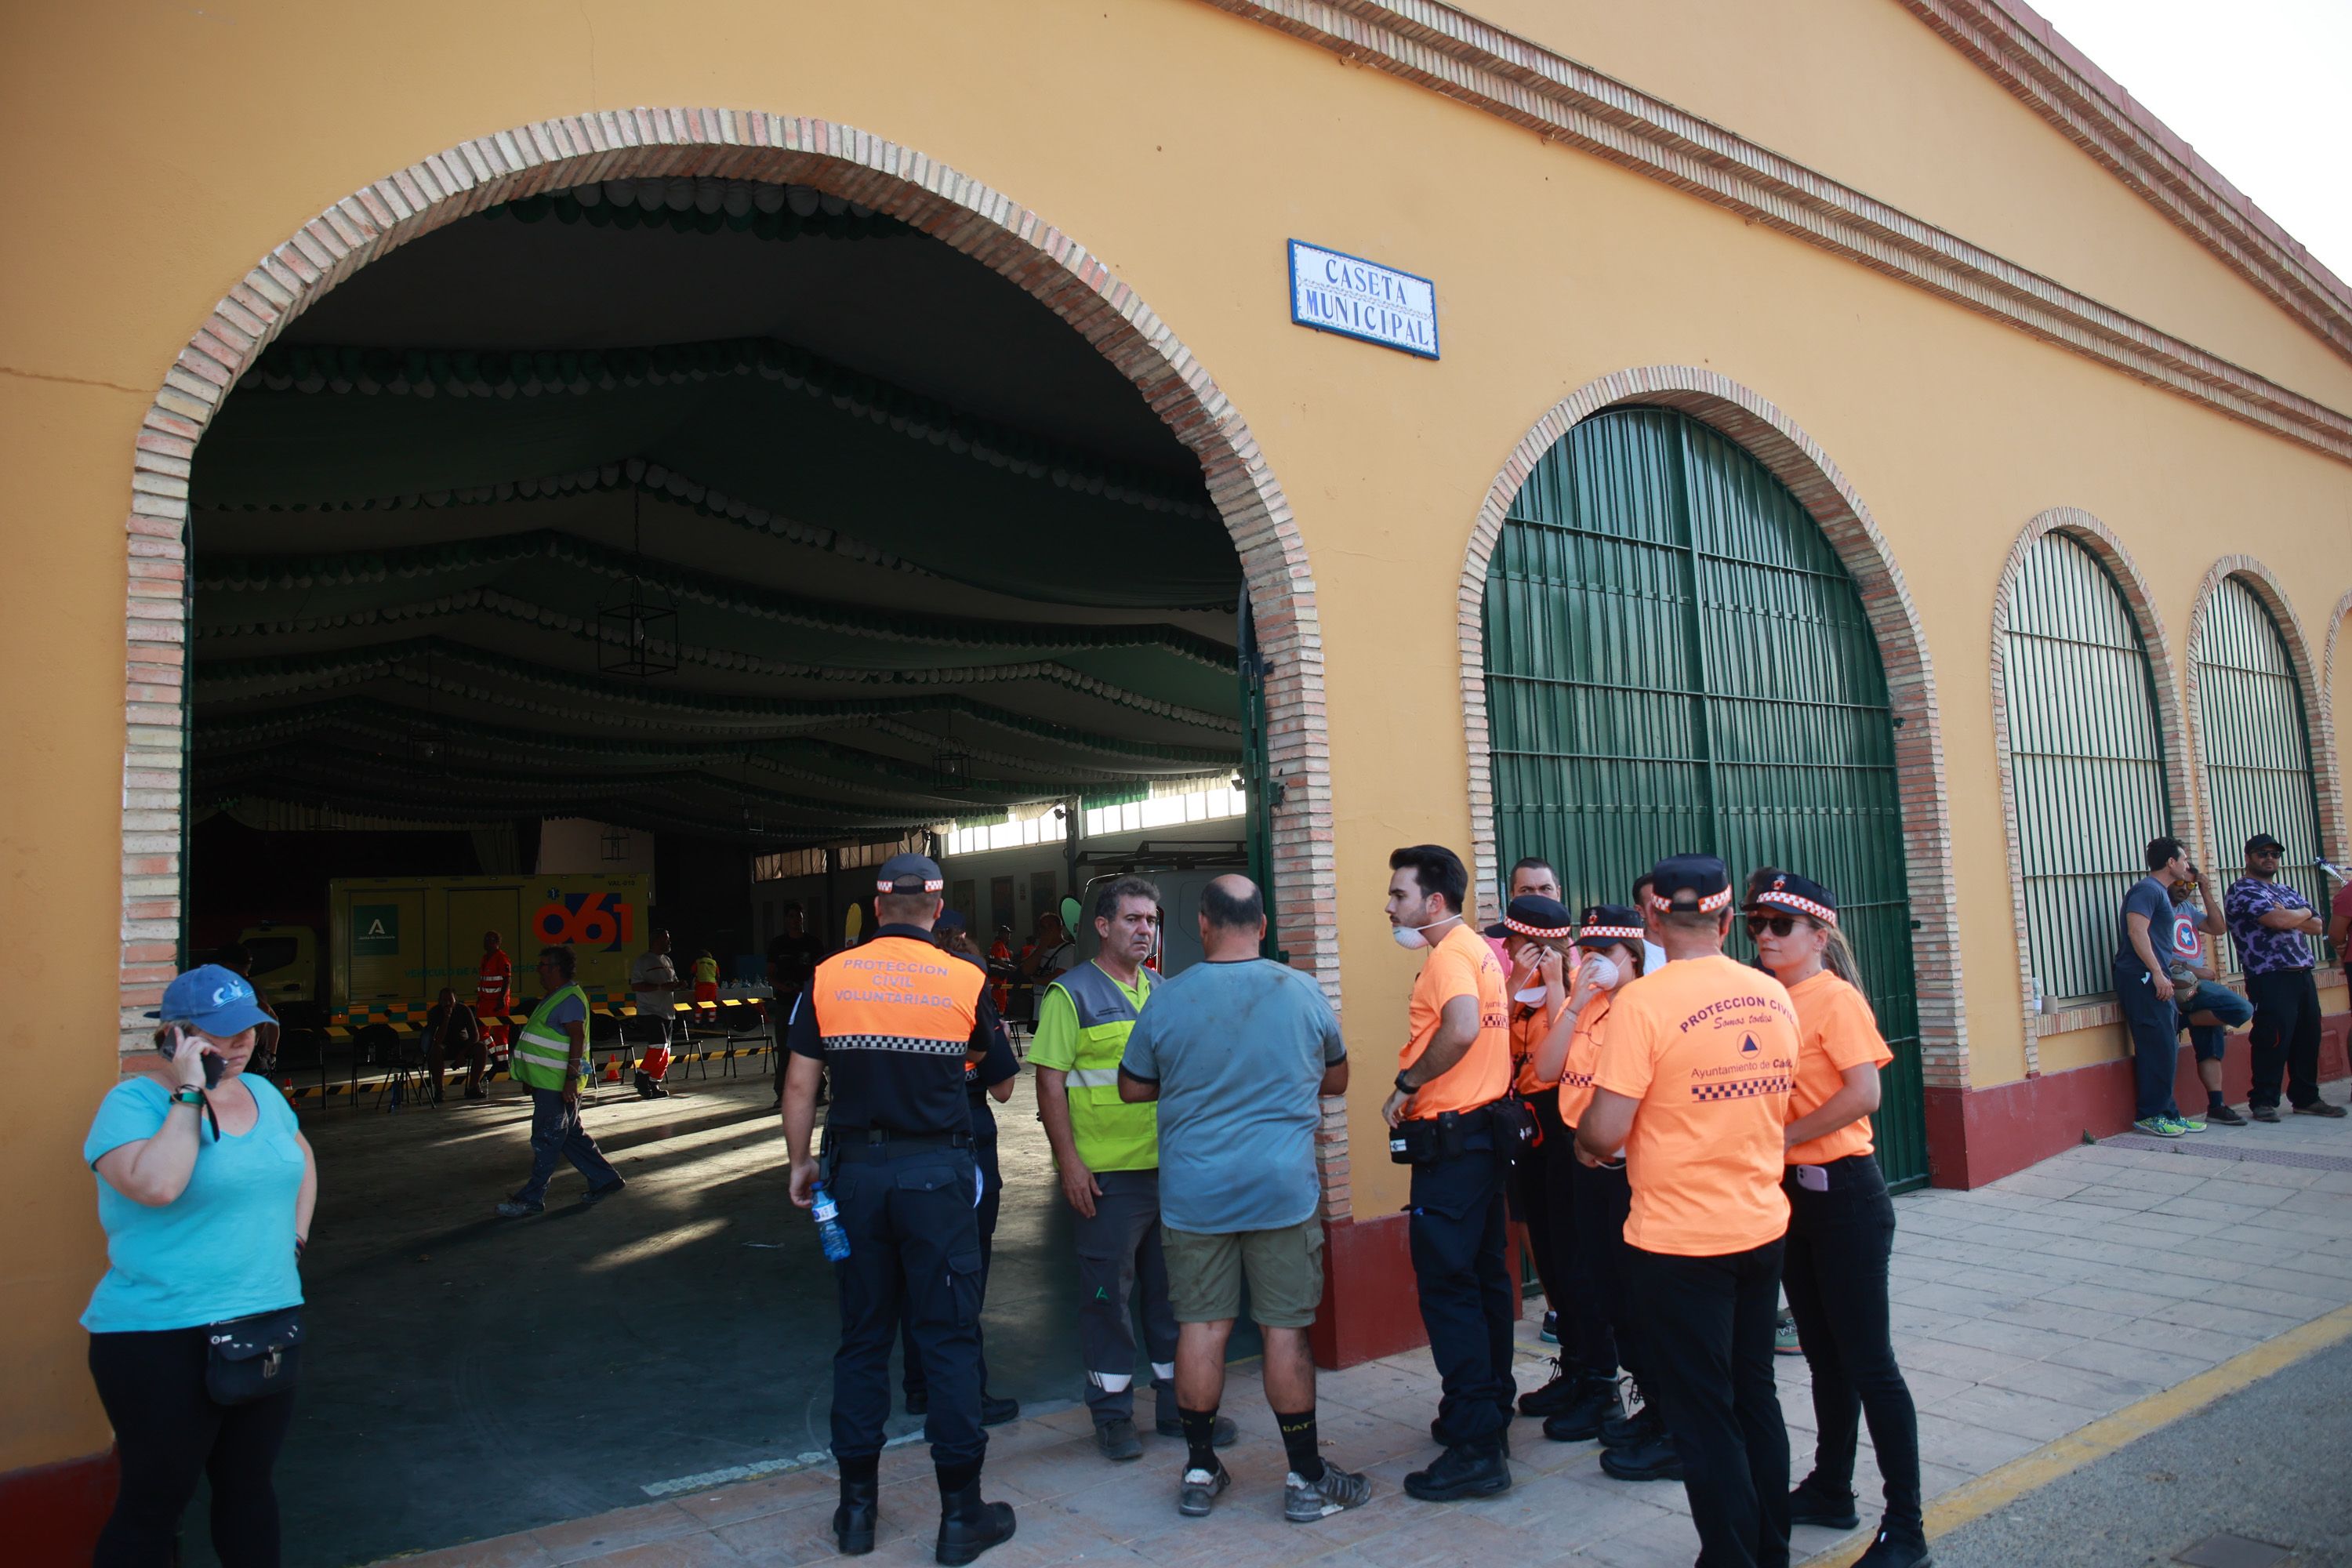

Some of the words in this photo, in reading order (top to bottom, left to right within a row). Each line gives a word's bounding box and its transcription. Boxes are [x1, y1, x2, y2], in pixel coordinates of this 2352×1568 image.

[1325, 259, 1406, 305] CASETA
[1305, 289, 1430, 347] MUNICIPAL
[532, 892, 633, 946] 061
[844, 959, 948, 976] PROTECCION
[872, 975, 915, 988] CIVIL
[834, 989, 953, 1008] VOLUNTARIADO
[1679, 996, 1766, 1033] PROTECCION
[1769, 1000, 1795, 1025] CIVIL
[1713, 1016, 1744, 1029] Somos
[1690, 1061, 1758, 1080] Ayuntamiento
[1759, 1060, 1770, 1069] de
